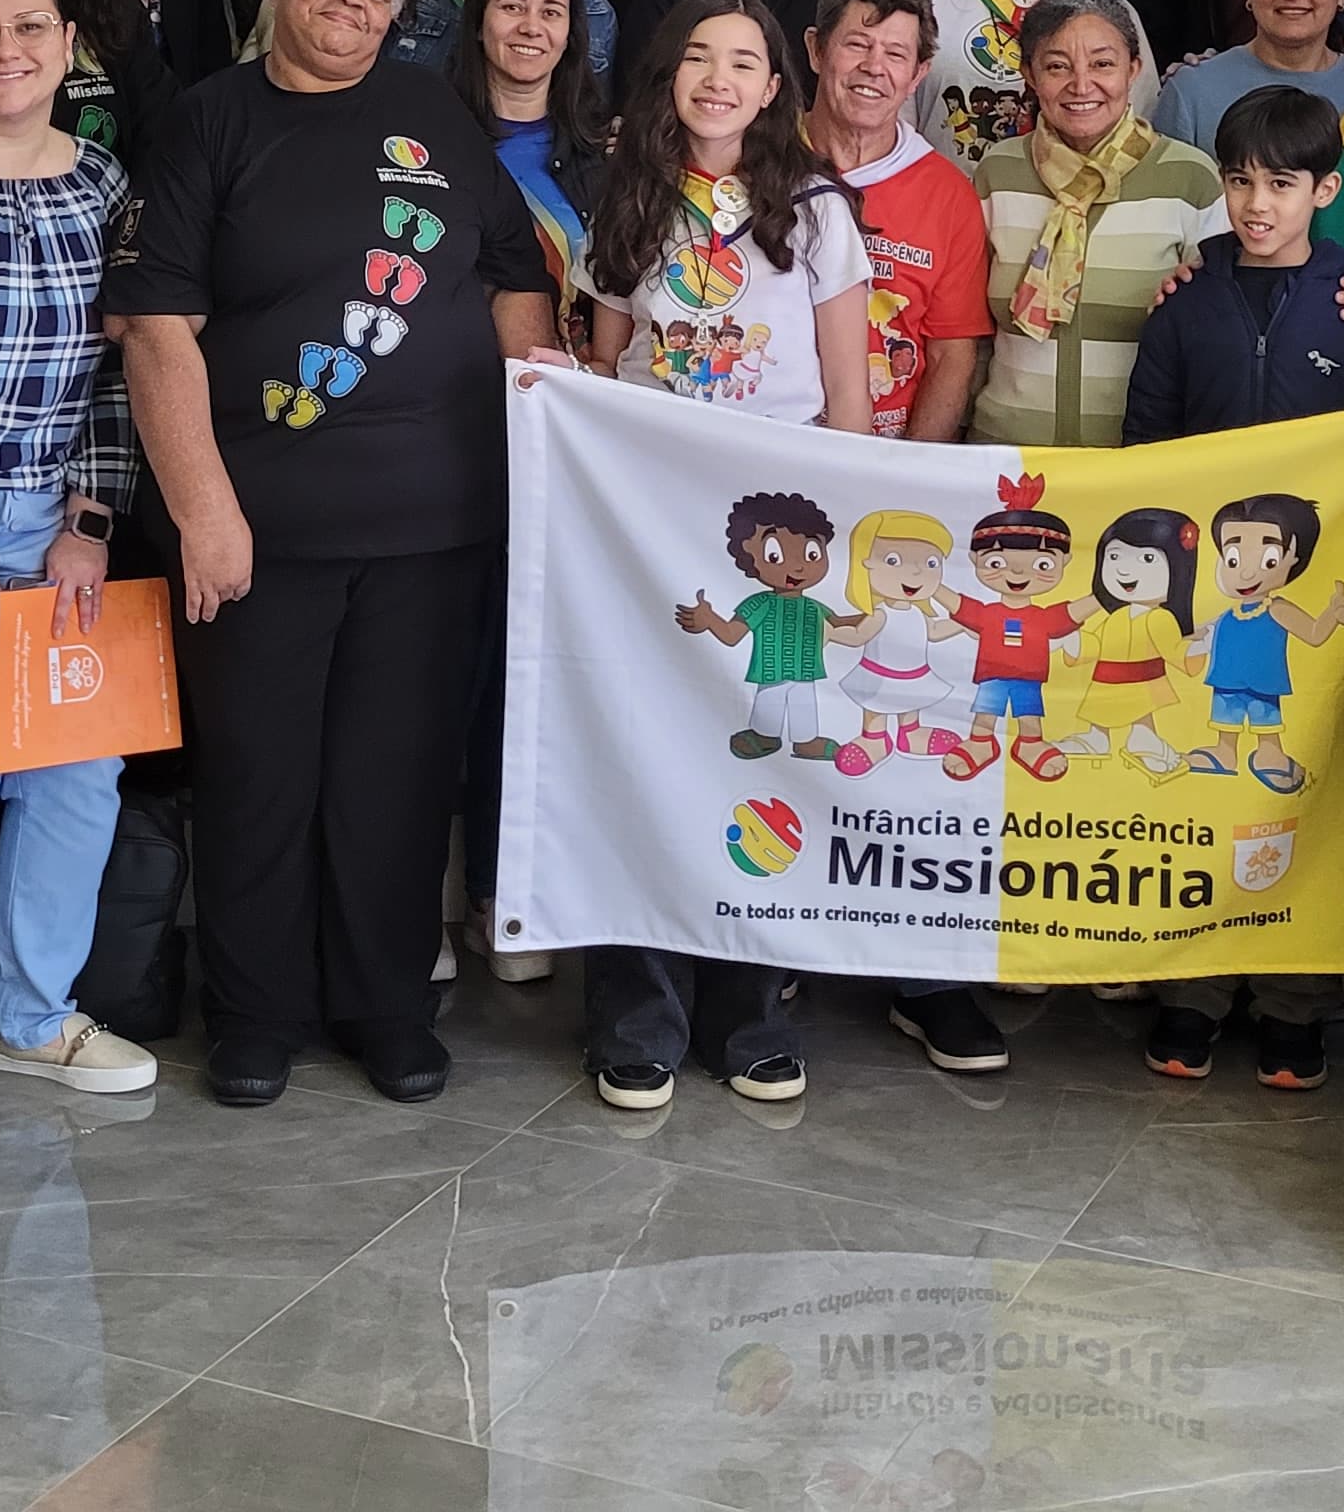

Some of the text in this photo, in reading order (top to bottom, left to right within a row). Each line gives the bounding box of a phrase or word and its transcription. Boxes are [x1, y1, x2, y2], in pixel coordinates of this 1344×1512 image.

[864, 236, 932, 267] OLESCÊNCIA
[831, 805, 1215, 847] Infância e Adolescência
[1250, 822, 1284, 838] POM
[828, 835, 1215, 909] Missionária
[715, 901, 1293, 944] De todas as crianças e adolescentes do mundo, sempre amigos!
